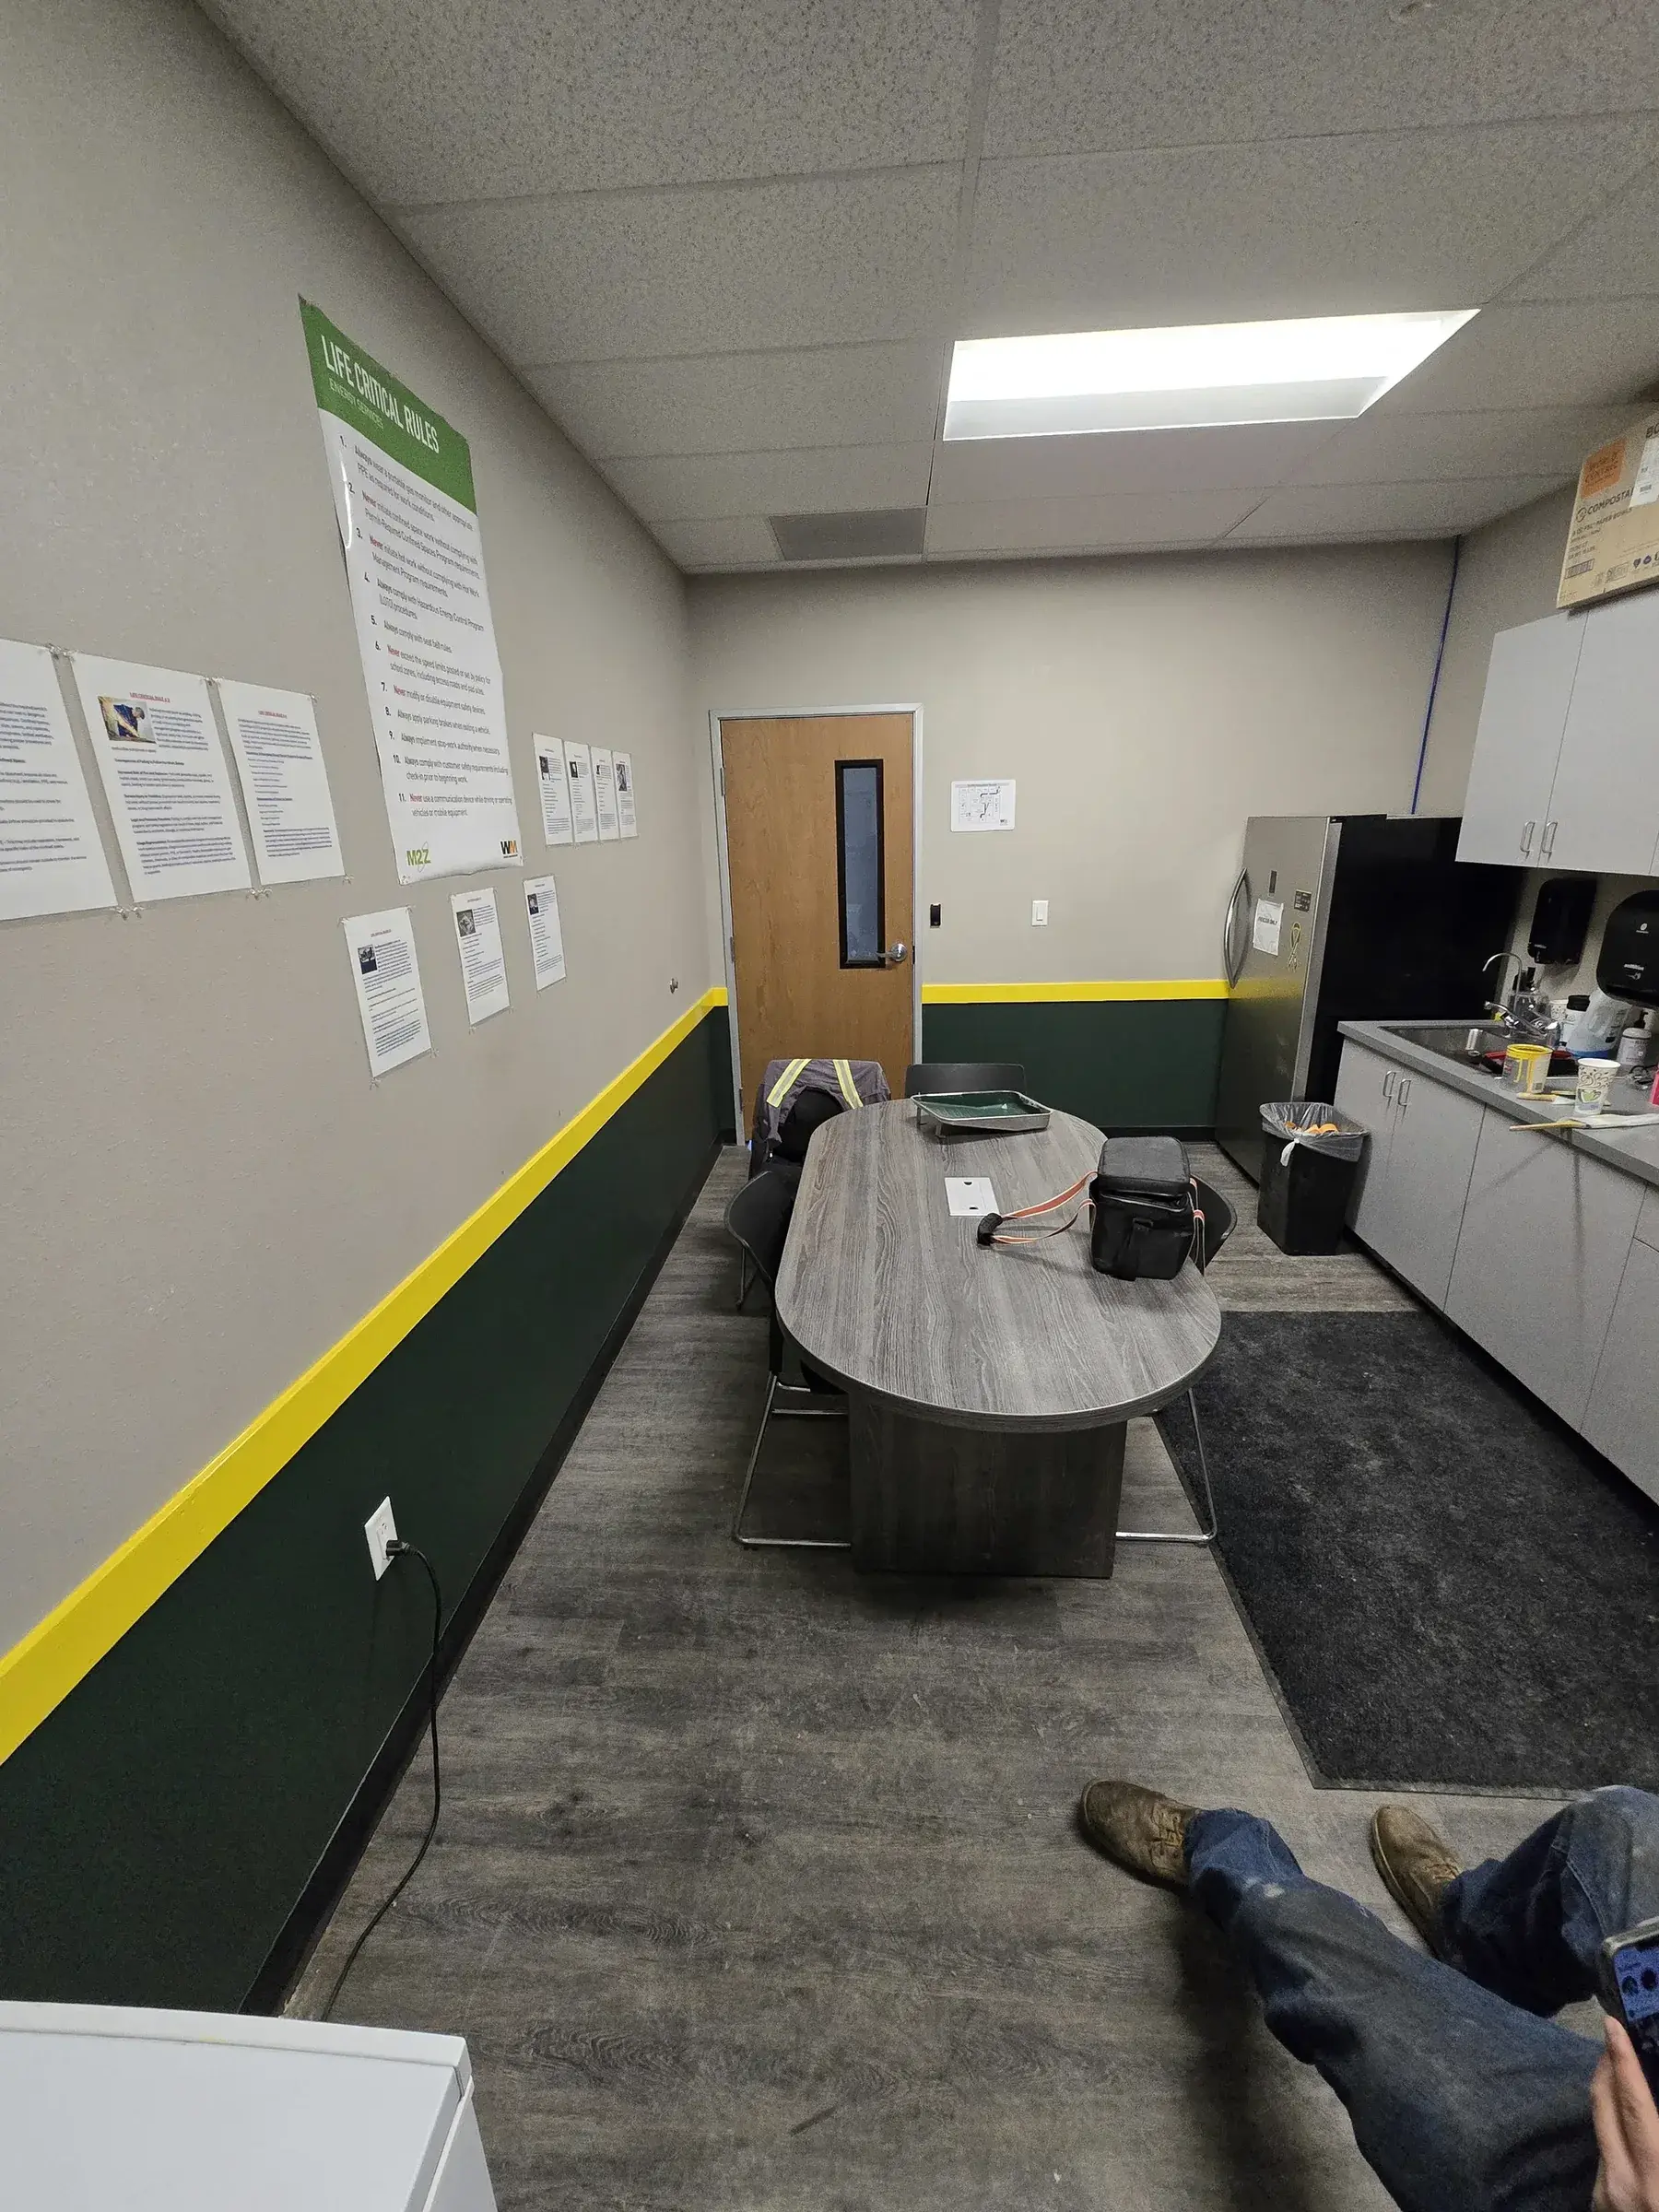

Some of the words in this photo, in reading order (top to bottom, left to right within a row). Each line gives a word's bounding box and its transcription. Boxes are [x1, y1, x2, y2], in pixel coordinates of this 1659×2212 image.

[321, 335, 354, 386] LIFE
[354, 362, 404, 429] CRITICAL
[404, 405, 440, 453] RULES
[329, 377, 357, 406] ENERGY
[356, 400, 384, 429] SERVICES
[340, 435, 347, 449] 1.
[348, 481, 355, 494] 2.
[361, 490, 377, 509] Never
[1587, 486, 1635, 514] COMPOSTA
[356, 527, 362, 539] 3.
[369, 535, 384, 551] Never
[364, 571, 371, 582] 4.
[371, 615, 377, 625] 5.
[375, 641, 382, 651] 6.
[387, 644, 401, 657] Never
[381, 682, 387, 691] 7.
[394, 685, 406, 697] Never
[385, 706, 392, 716] 8.
[389, 731, 394, 739] 9.
[393, 754, 401, 763] 10.
[409, 794, 423, 802] Never
[500, 840, 517, 854] WM
[406, 848, 431, 866] M2Z
